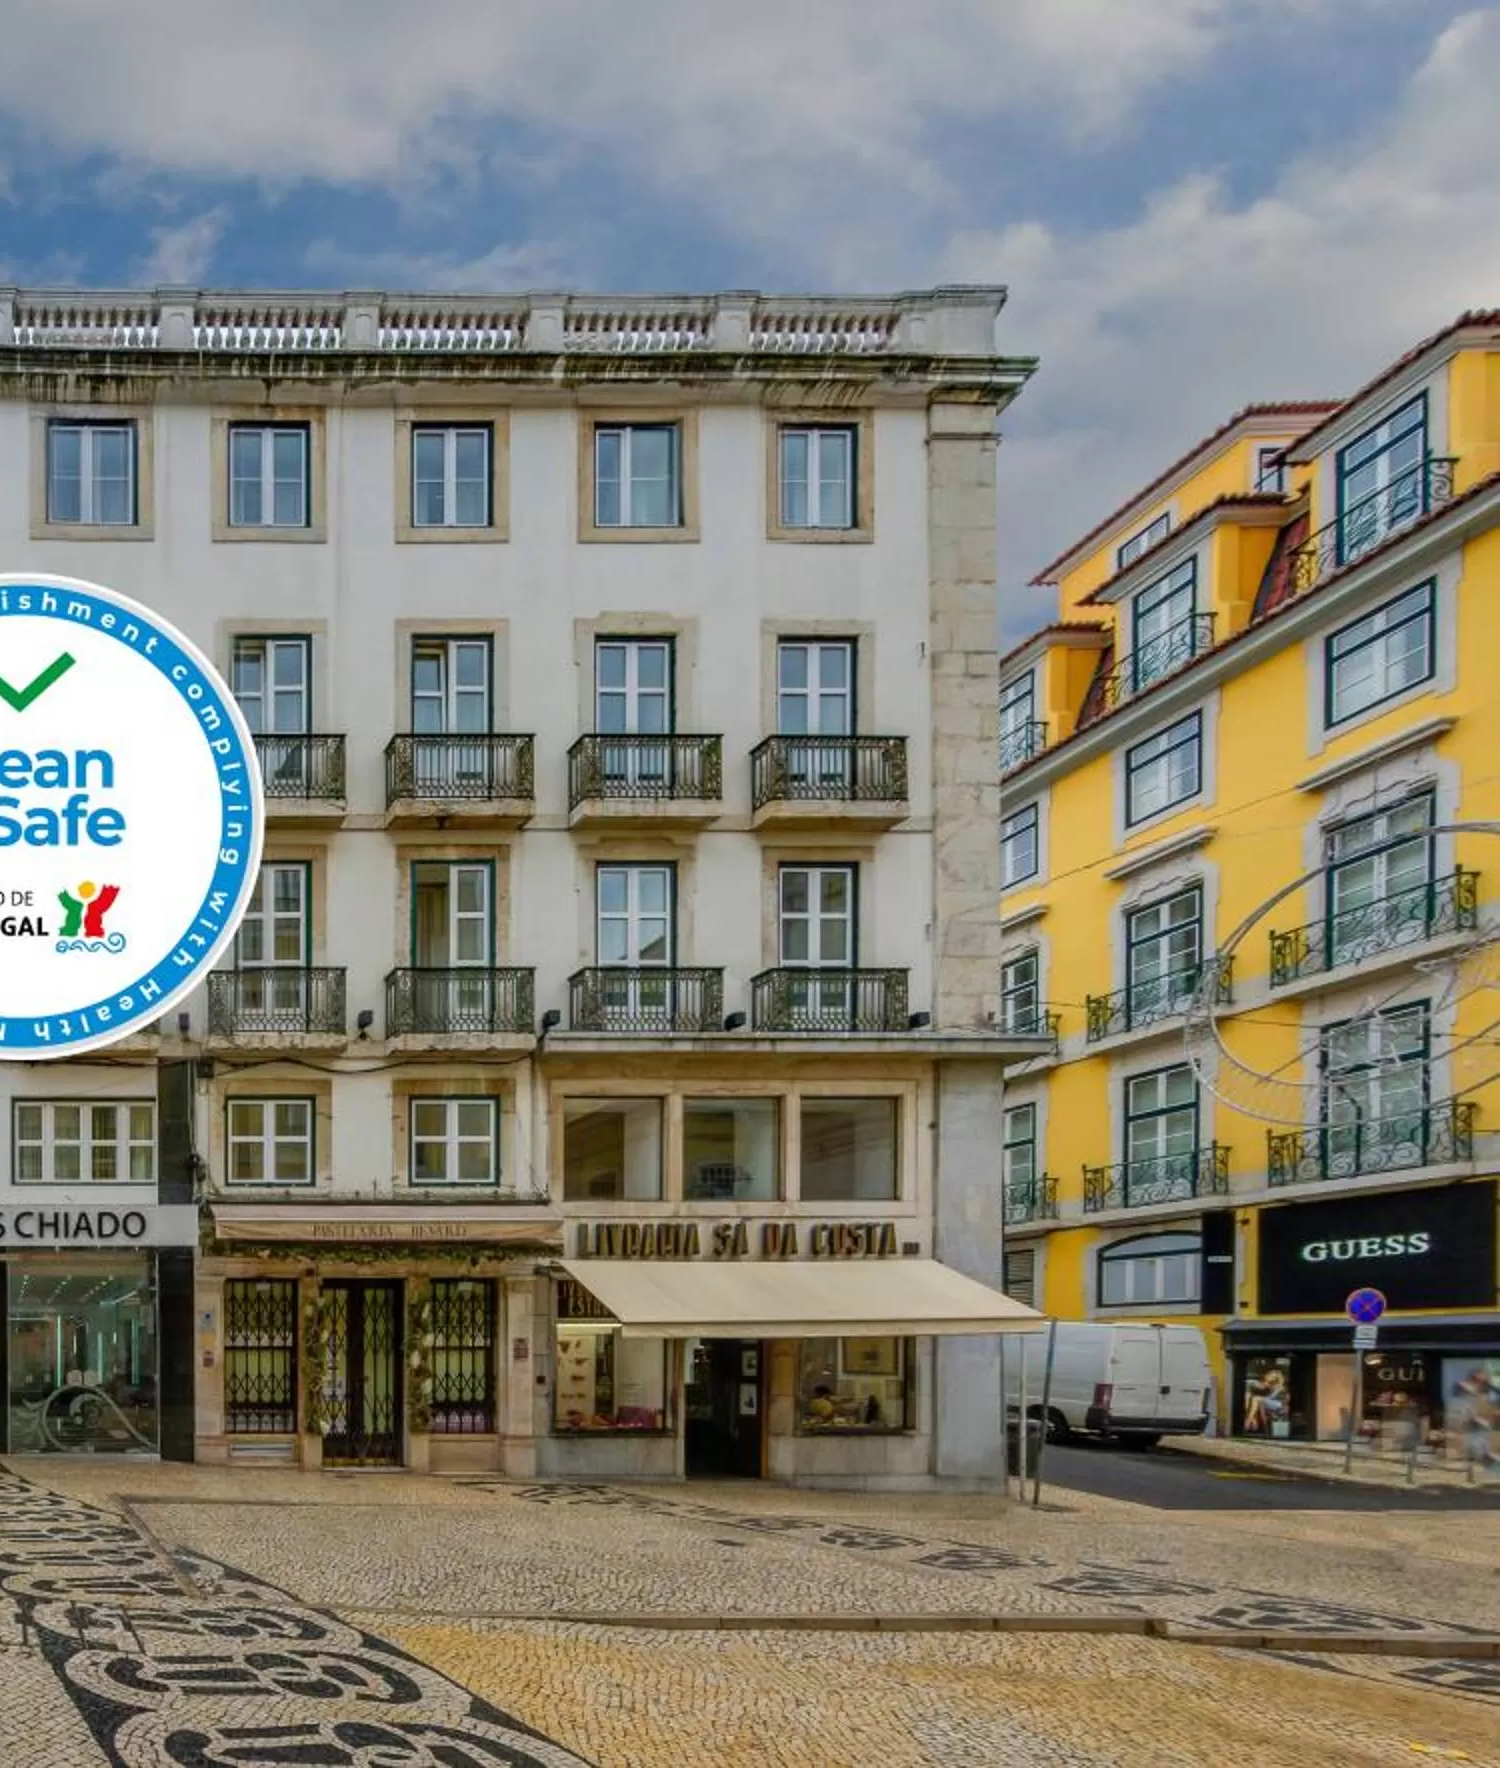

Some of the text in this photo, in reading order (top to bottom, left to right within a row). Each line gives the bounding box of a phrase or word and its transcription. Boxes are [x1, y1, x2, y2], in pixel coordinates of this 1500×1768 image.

[13, 1211, 147, 1239] CHIADO
[577, 1223, 700, 1258] LIVRARIA
[762, 1223, 799, 1257] DA
[810, 1222, 899, 1256] COSTA
[1303, 1232, 1431, 1262] GUESS
